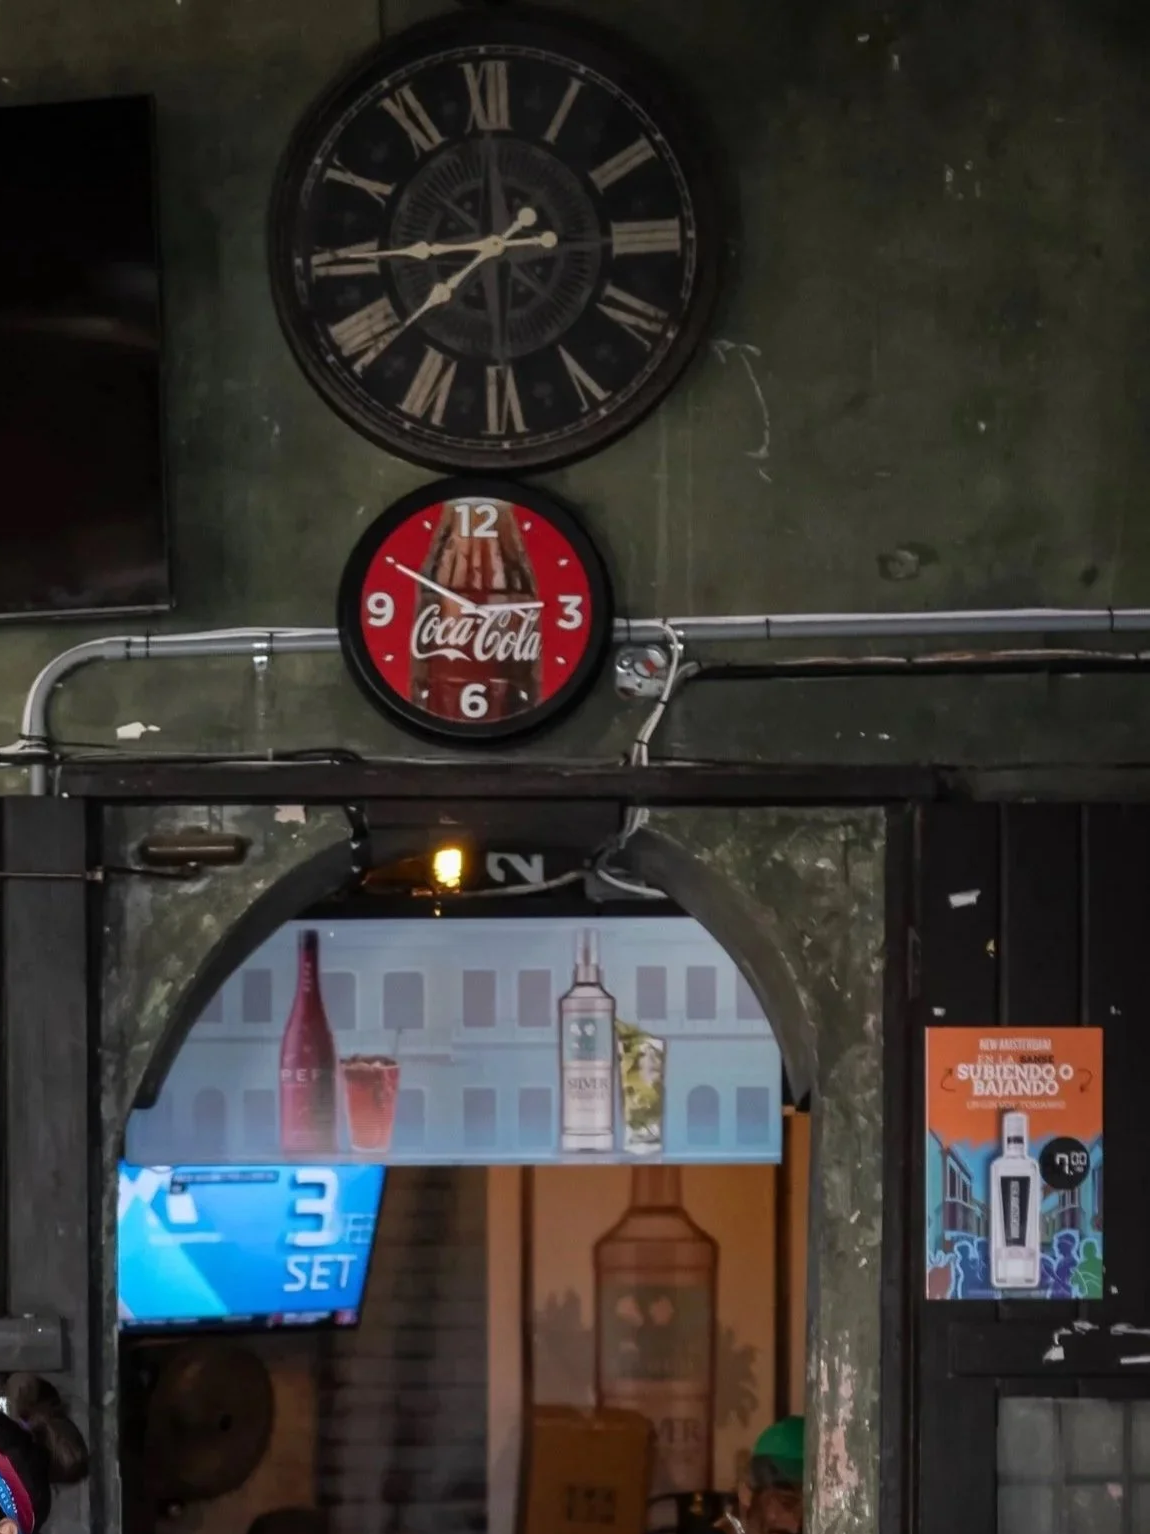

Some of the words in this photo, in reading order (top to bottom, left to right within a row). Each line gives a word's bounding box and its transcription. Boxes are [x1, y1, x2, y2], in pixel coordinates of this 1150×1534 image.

[455, 504, 499, 538] 12
[367, 592, 395, 626] 9
[557, 595, 583, 630] 3
[411, 603, 542, 662] Coca-Cola
[460, 683, 488, 718] 6
[957, 1063, 1056, 1081] SUBIENDO
[1059, 1063, 1074, 1080] O
[1019, 1054, 1054, 1064] SANSE
[973, 1080, 1059, 1098] BAJANDO
[286, 1168, 340, 1247] 3
[283, 1254, 358, 1293] SET
